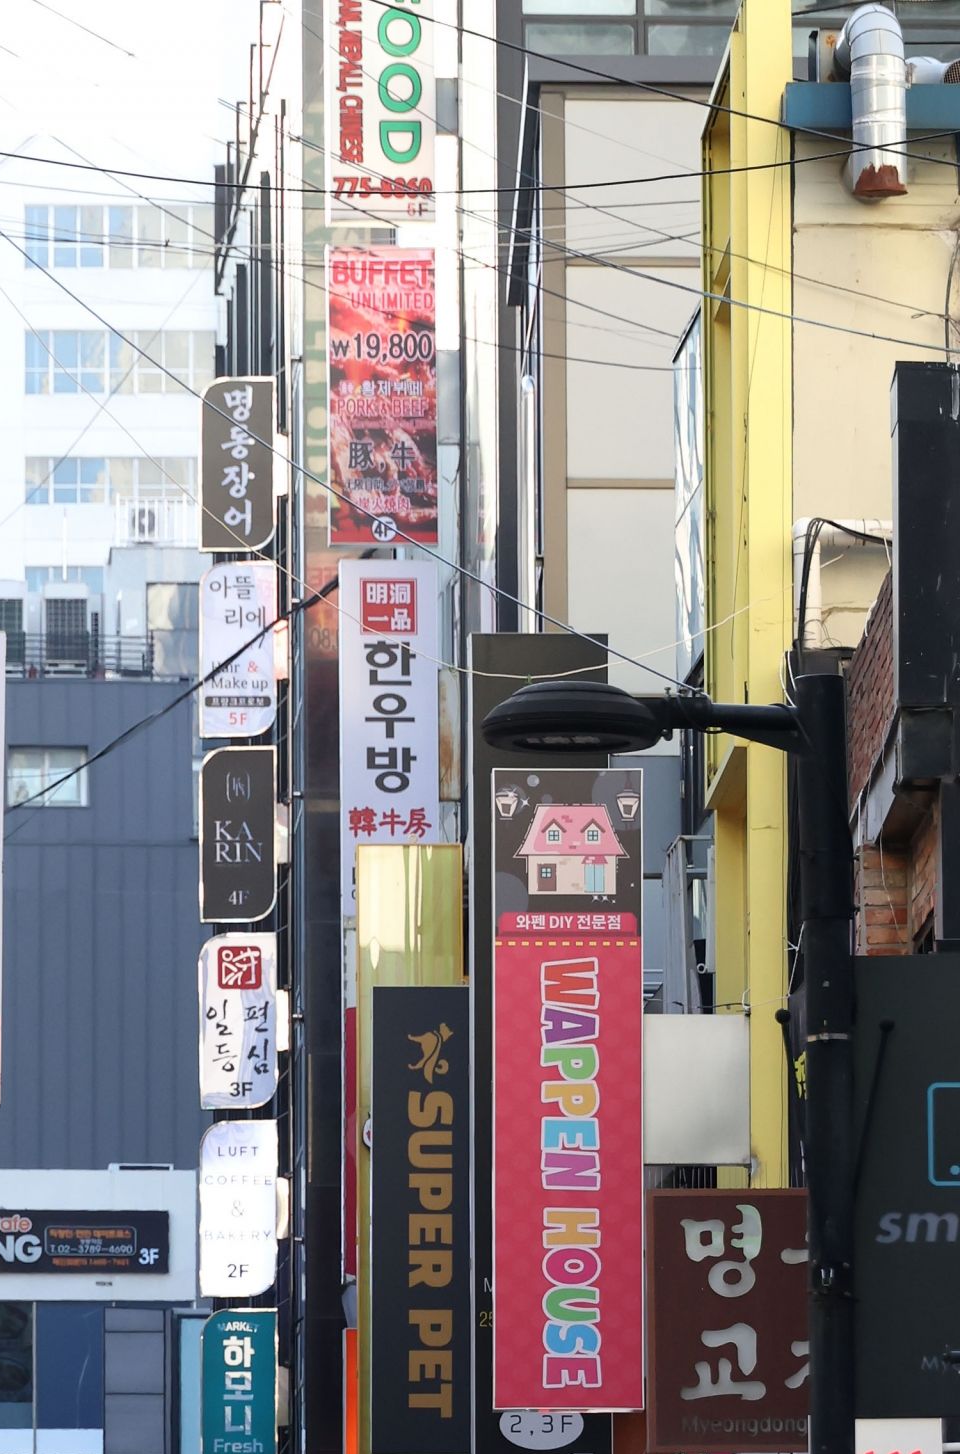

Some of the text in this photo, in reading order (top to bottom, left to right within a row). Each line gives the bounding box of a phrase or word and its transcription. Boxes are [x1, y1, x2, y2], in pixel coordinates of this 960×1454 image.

[378, 0, 422, 163] OOD
[332, 260, 433, 286] BUFFET
[351, 292, 433, 309] UNLIMITED
[337, 399, 376, 417] PORK
[392, 399, 428, 417] BEEF
[221, 384, 256, 536] 명동장어
[366, 582, 411, 605] 明洞
[225, 605, 267, 630] 리에
[367, 607, 411, 631] 一品
[247, 660, 259, 674] &
[211, 676, 269, 693] Make up
[229, 712, 248, 725] 5F
[363, 640, 418, 794] 한우방
[214, 820, 254, 841] KA
[348, 806, 433, 838] 韓牛房
[214, 842, 263, 863] RIN
[516, 914, 622, 930] 와펜 DIY 전문점
[540, 957, 601, 1191] WAPPEN
[229, 1081, 254, 1098] 3F
[217, 1146, 259, 1157] LUFT
[204, 1175, 273, 1186] COFFEE
[407, 1091, 454, 1289] SUPER
[204, 1230, 272, 1241] BAKERY
[138, 1248, 160, 1265] 3F
[680, 1203, 810, 1298] 명
[227, 1263, 250, 1278] 2F
[542, 1207, 602, 1389] HOUSE
[407, 1309, 454, 1419] PET
[222, 1335, 256, 1436] 하모니
[213, 1438, 264, 1454] Fresh
